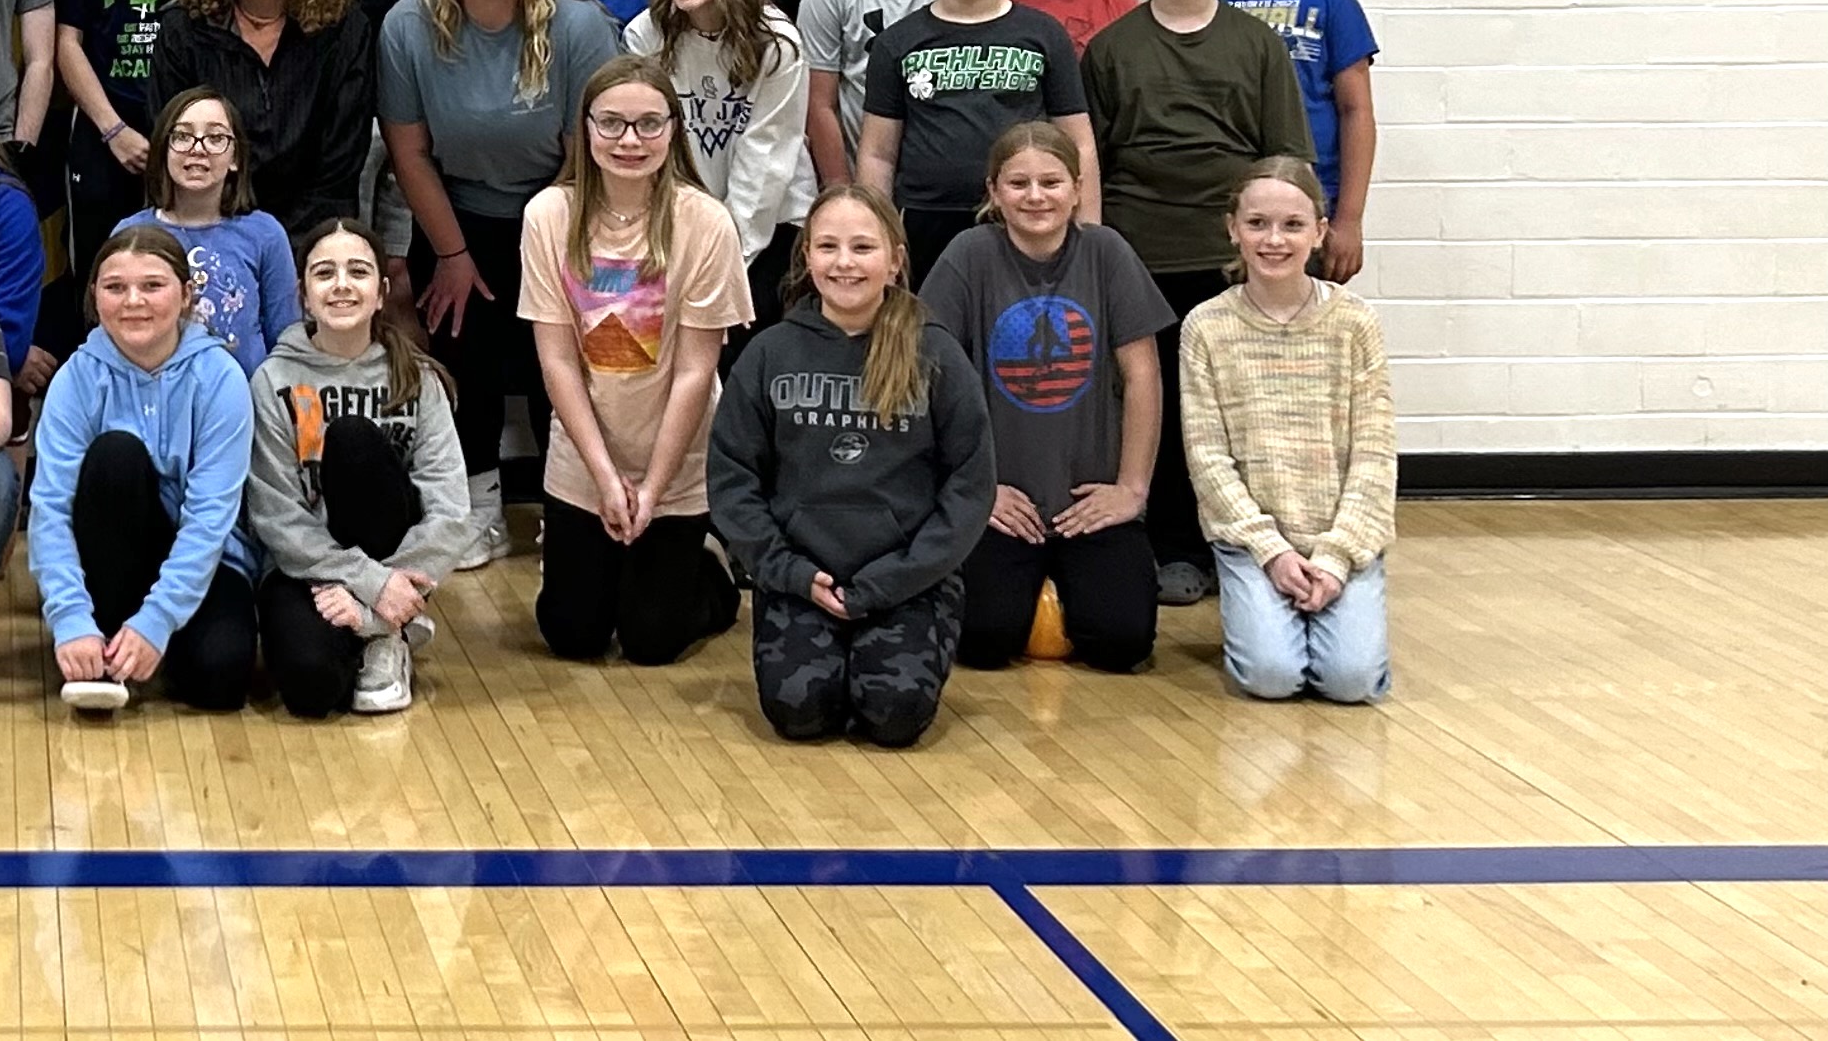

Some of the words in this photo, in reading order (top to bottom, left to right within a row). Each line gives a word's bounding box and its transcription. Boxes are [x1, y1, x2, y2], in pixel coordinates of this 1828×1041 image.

[902, 46, 1045, 77] RICHLAND
[936, 70, 980, 90] HOT
[979, 70, 1038, 92] SHOTS
